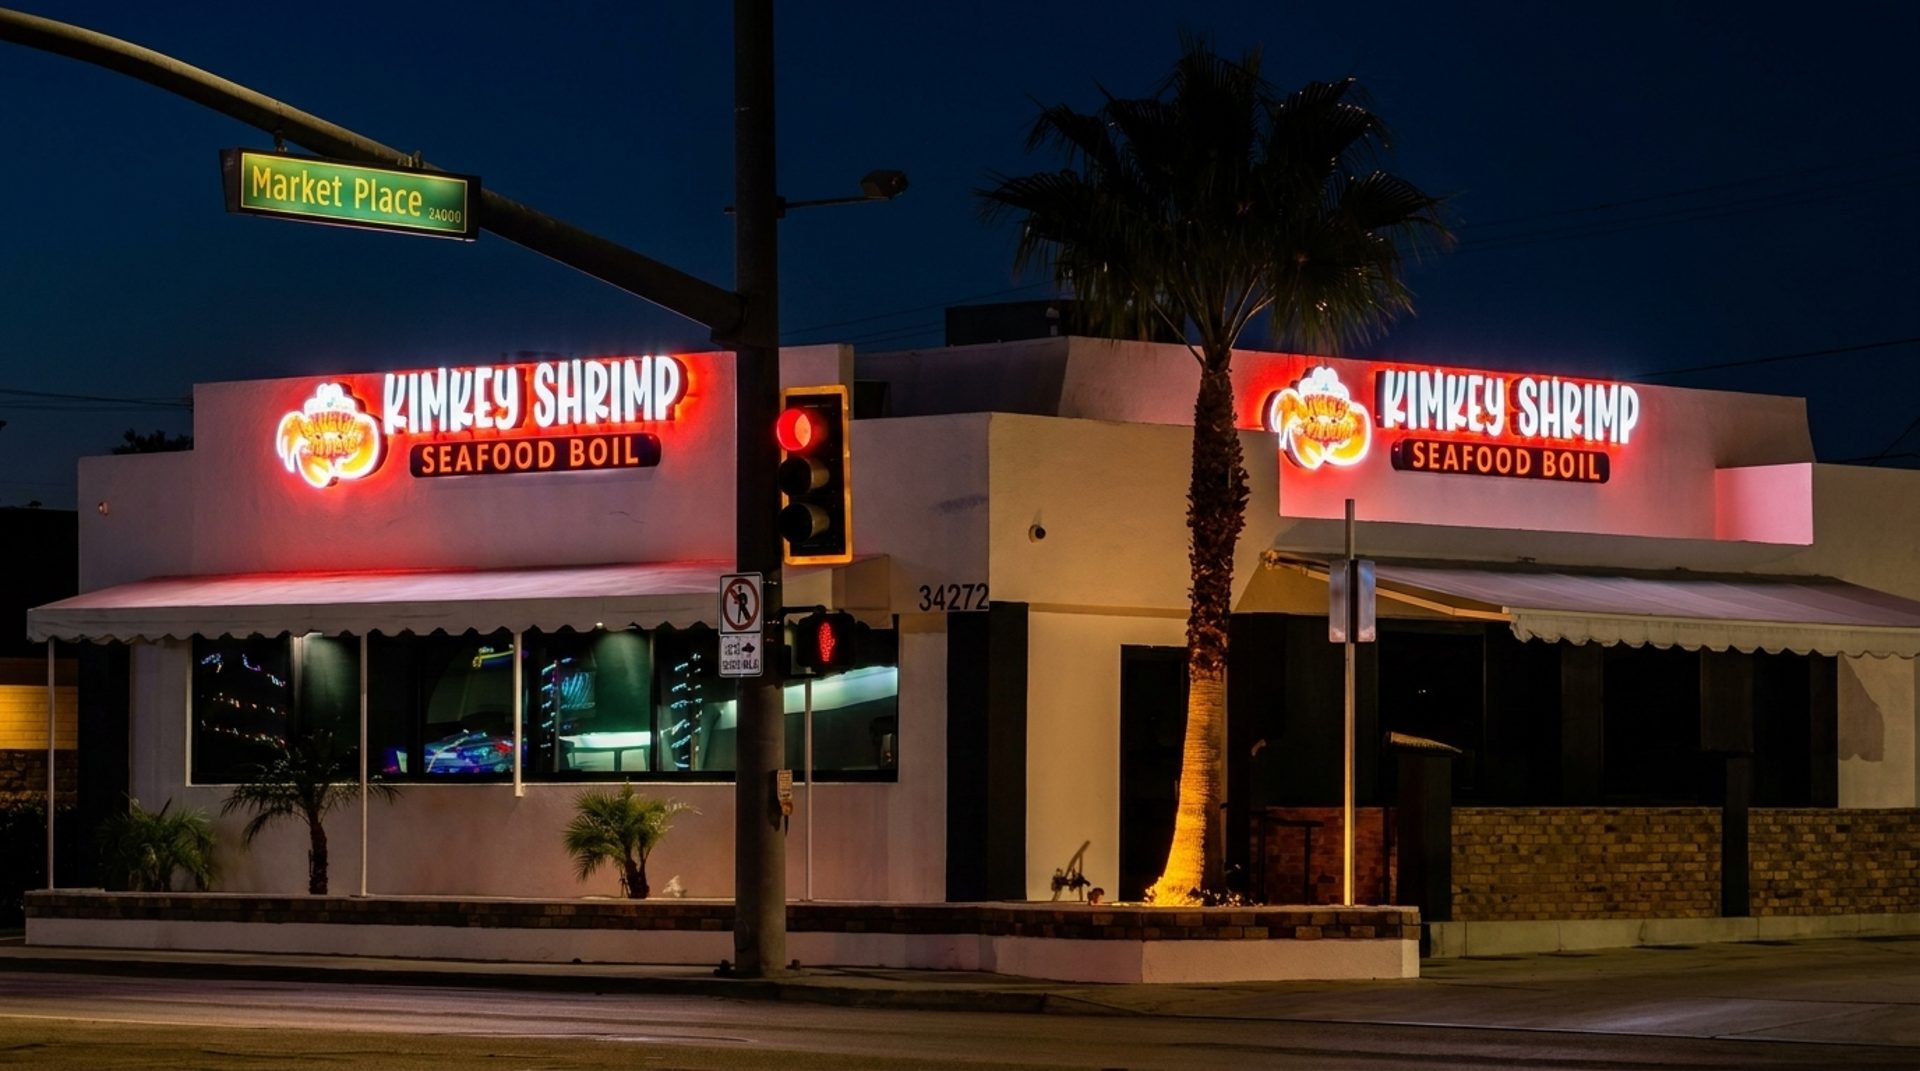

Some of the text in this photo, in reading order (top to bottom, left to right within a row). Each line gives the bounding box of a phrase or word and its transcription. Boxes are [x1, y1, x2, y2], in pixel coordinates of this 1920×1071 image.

[251, 165, 423, 217] Market Place
[383, 355, 683, 436] KIMKEY SHRIMP
[1383, 370, 1506, 436] KIMKEY
[1518, 377, 1640, 444] SHRIMP
[422, 436, 640, 475] SEAFOOD BOIL
[1412, 441, 1601, 481] SEAFOOD BOIL
[919, 583, 989, 612] 34272
